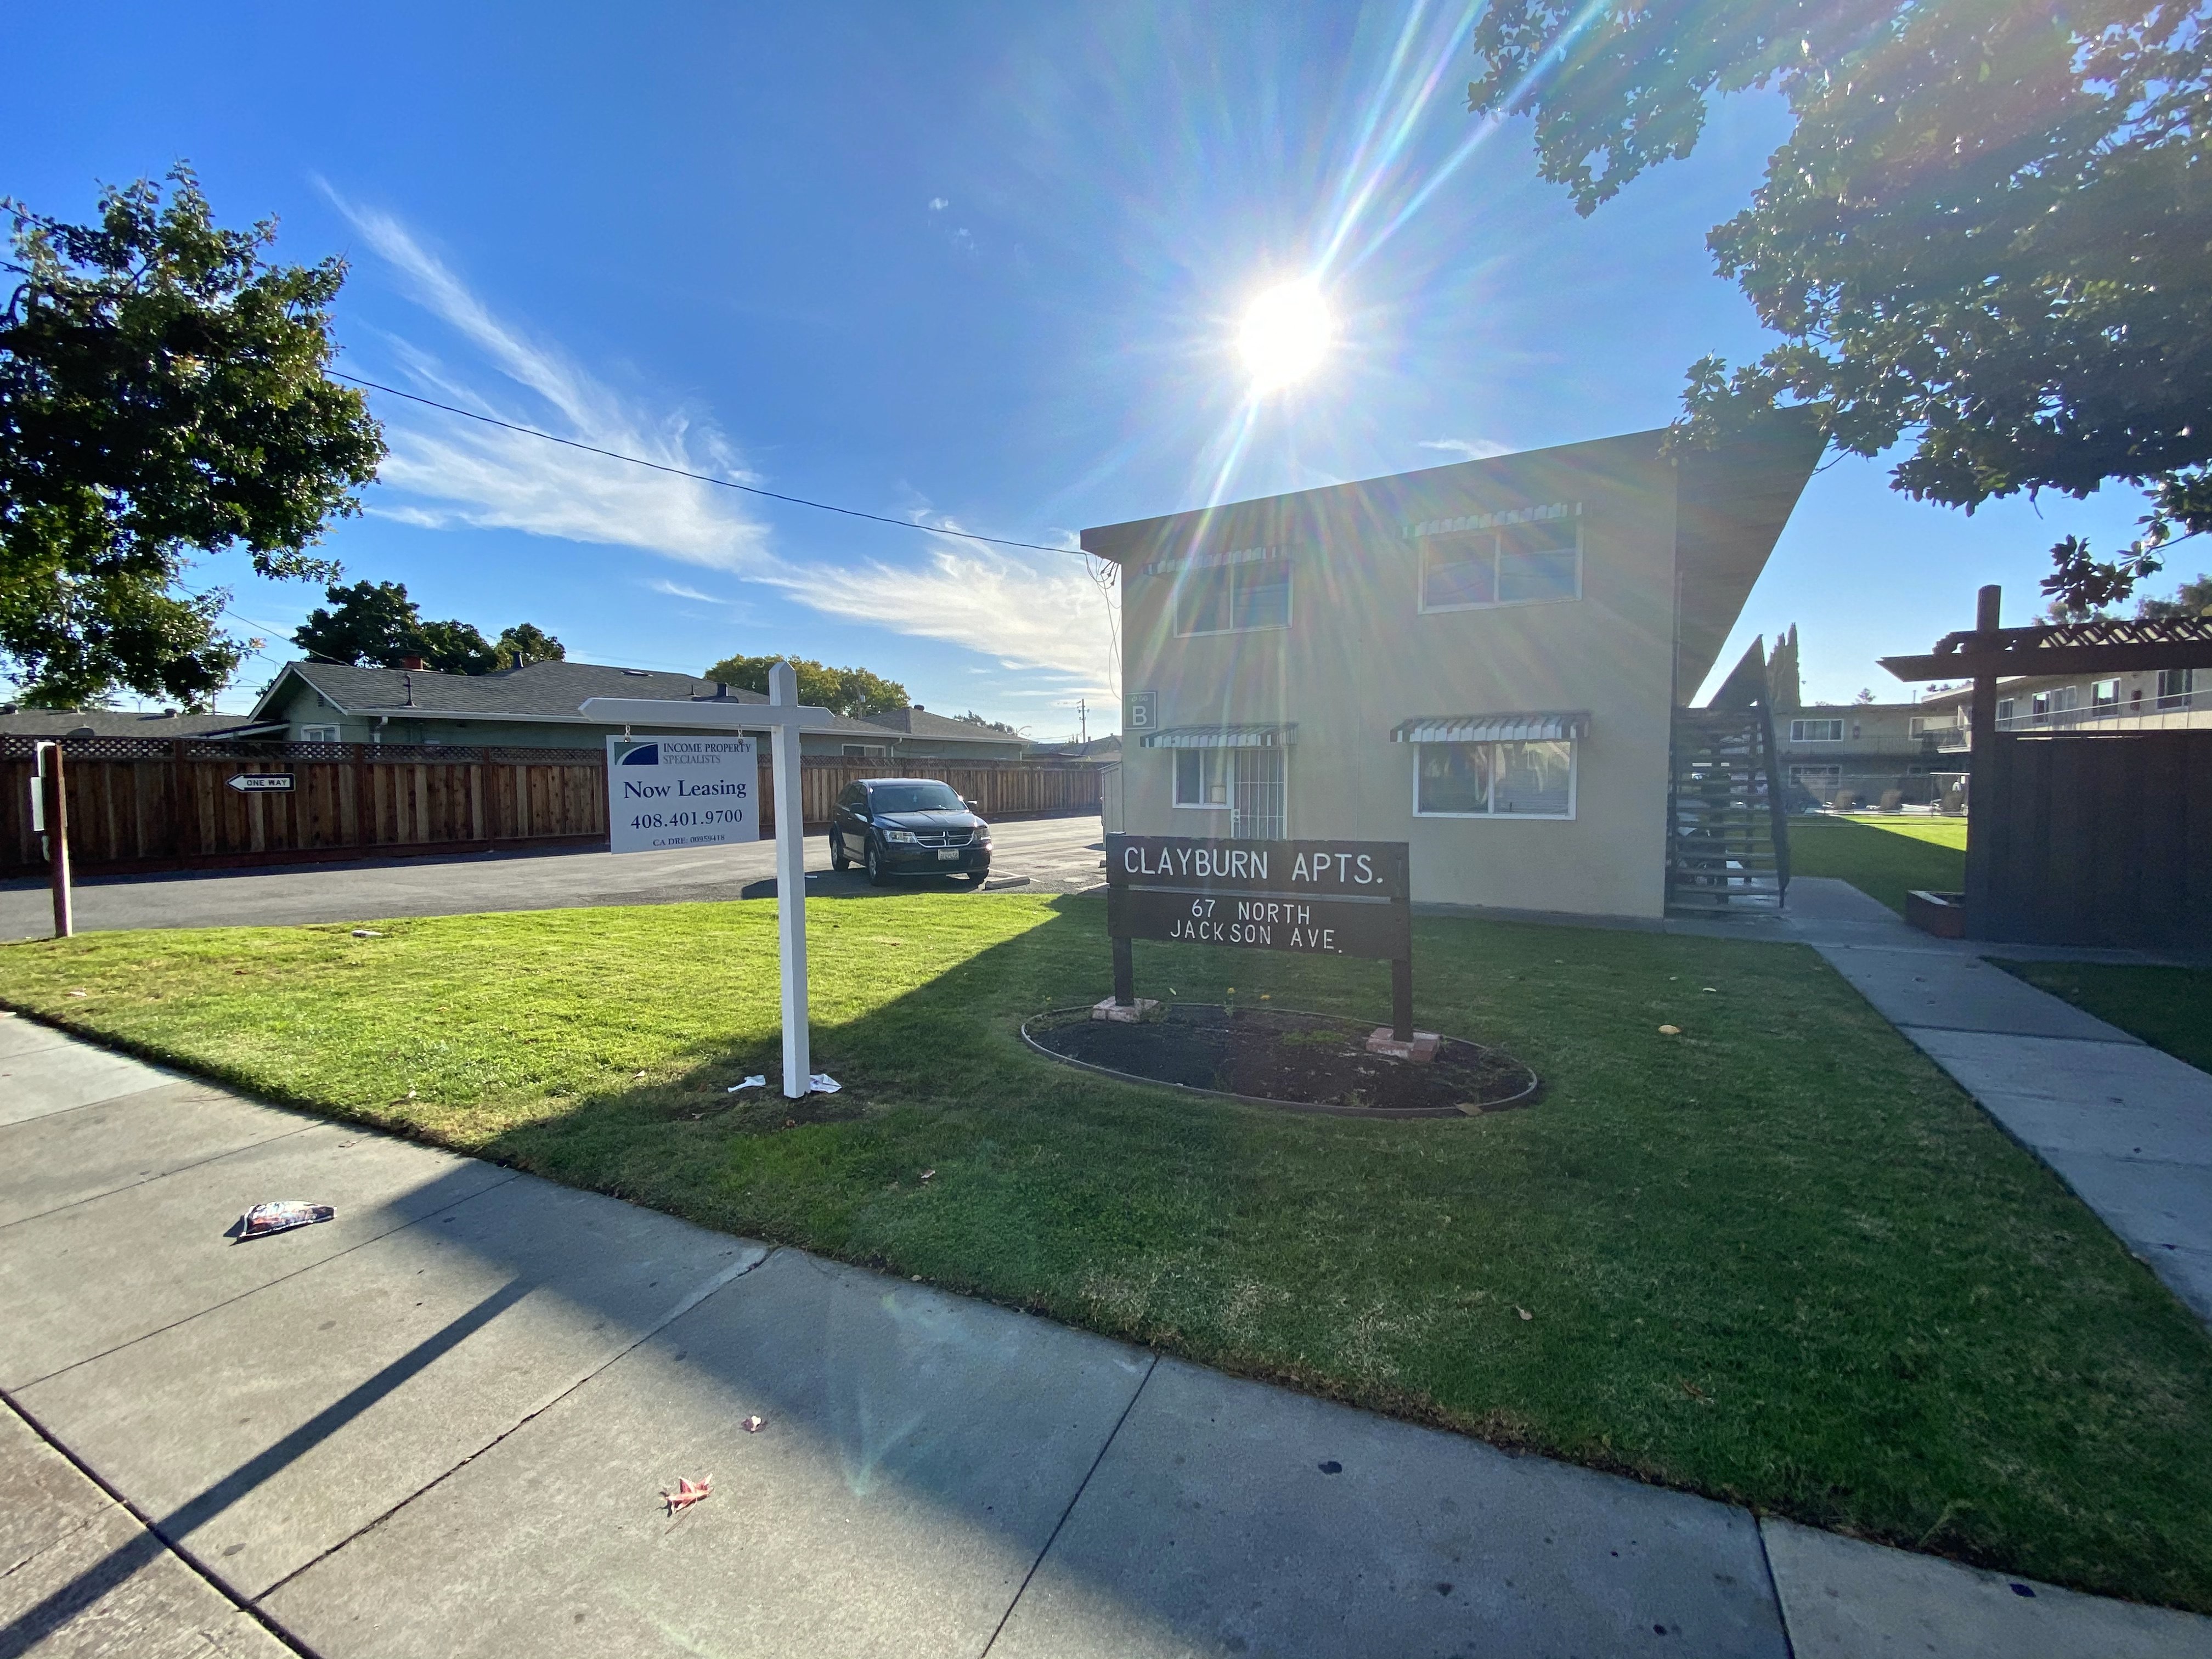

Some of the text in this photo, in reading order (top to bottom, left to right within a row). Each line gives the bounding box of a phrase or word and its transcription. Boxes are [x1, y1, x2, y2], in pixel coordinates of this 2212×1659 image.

[1132, 706, 1147, 726] B
[663, 743, 751, 753] INCOME PROPERTY
[663, 754, 720, 764] SPECIALISTS
[623, 780, 746, 799] Now Leasing
[631, 809, 743, 829] 408.401.9700
[1124, 847, 1384, 884] CLAYBURN APTS.
[1192, 899, 1310, 925] 67 NORTH
[1170, 919, 1343, 953] JACKSON AVE.
